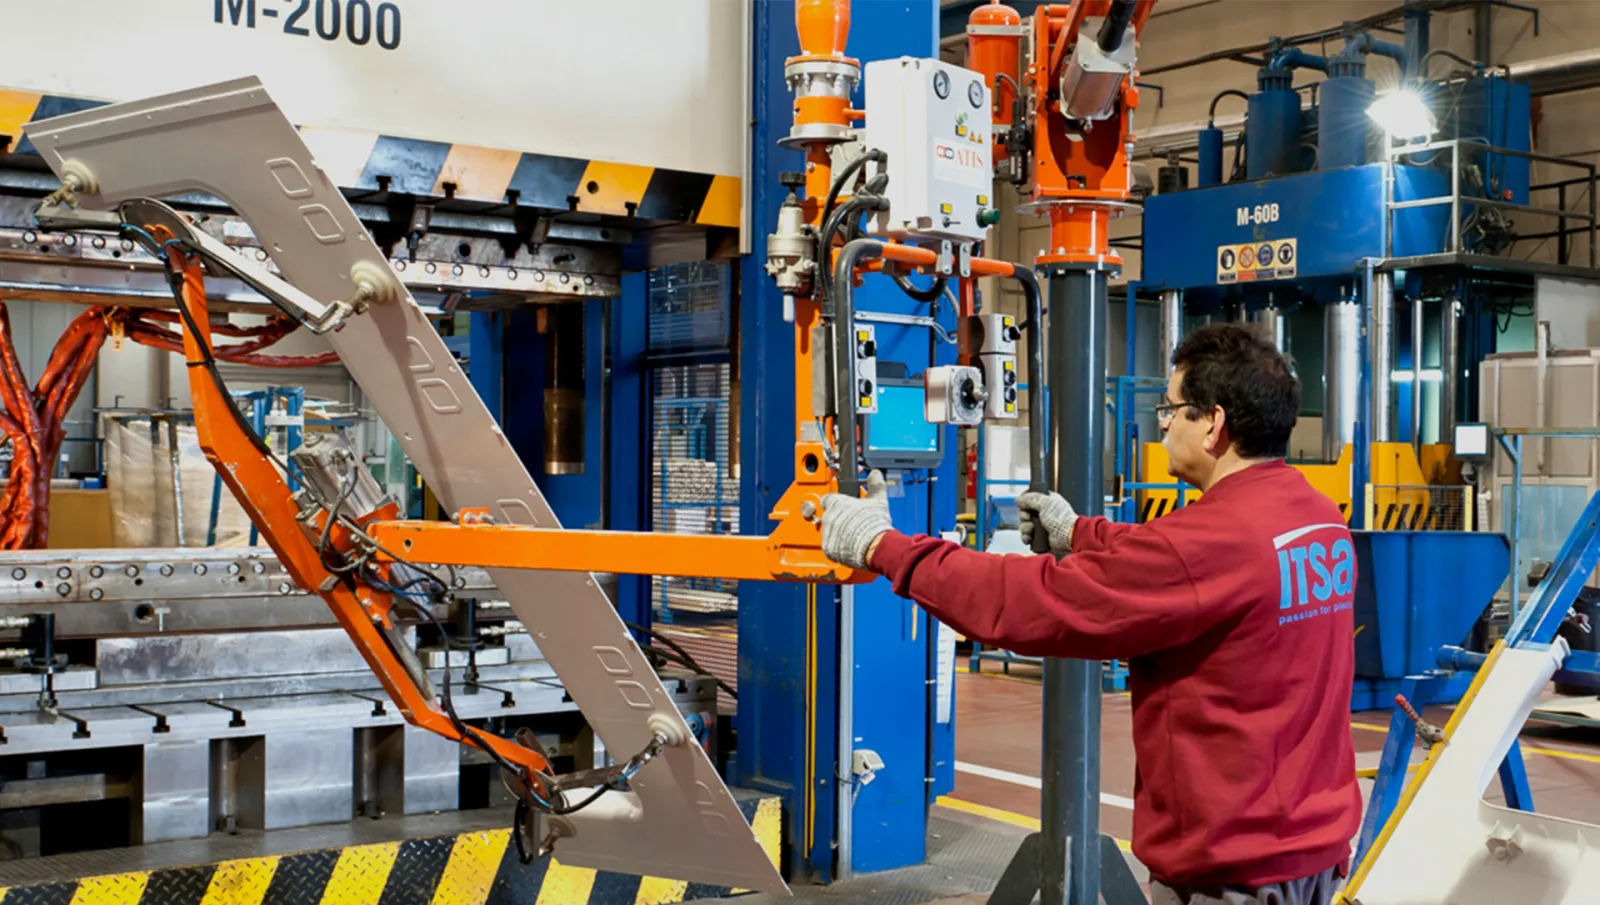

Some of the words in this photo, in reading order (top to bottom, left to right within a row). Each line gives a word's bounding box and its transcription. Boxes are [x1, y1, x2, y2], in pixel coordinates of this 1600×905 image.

[214, 0, 400, 50] M-2000
[955, 148, 983, 168] ATIS
[1237, 203, 1279, 226] M-60B
[1279, 609, 1318, 625] passion
